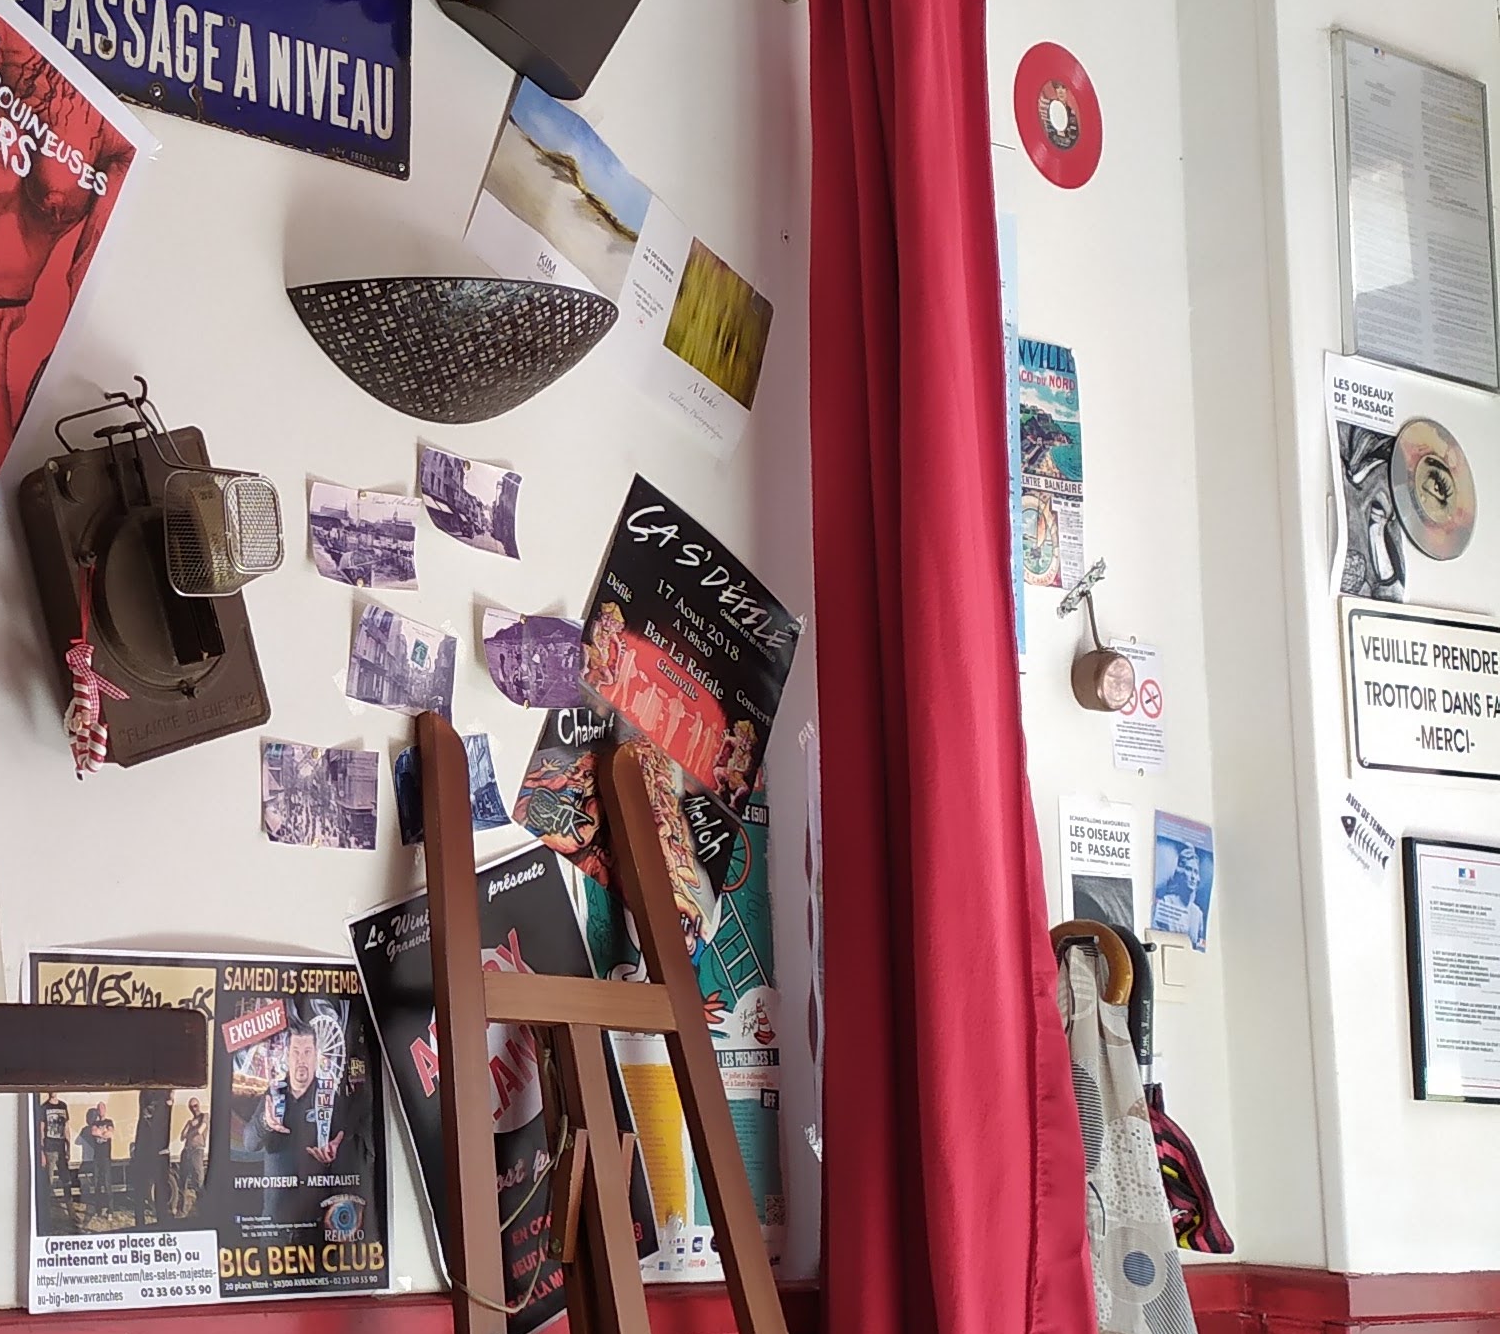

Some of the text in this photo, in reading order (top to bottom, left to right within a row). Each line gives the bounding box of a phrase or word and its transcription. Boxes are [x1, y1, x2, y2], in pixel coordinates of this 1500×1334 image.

[234, 23, 257, 103] A
[269, 33, 395, 142] NIVEAU
[1333, 376, 1394, 403] LES OISEAUX
[1334, 391, 1395, 418] DE PASSAGE
[606, 570, 633, 604] Défilé
[655, 577, 676, 600] 17
[707, 623, 741, 663] 2018
[681, 625, 714, 658] 18h30
[1360, 634, 1500, 676] VEUILLEZ PRENDRE
[643, 619, 725, 701] Bar La Rafale
[655, 656, 700, 701] Granville
[1364, 680, 1482, 717] TROTTOIR DANS
[557, 707, 607, 749] Chabert
[1415, 727, 1476, 755] -MERCI-
[1069, 824, 1131, 844] LES OISEAUX
[1070, 840, 1131, 860] DE PASSAGE
[487, 861, 546, 902] présente
[364, 923, 386, 950] Le
[223, 966, 298, 995] SAMEDI 15
[228, 1007, 283, 1045] EXCLUSIF
[234, 1174, 361, 1189] HYPNOTISEUR MENTALISTE
[36, 1248, 200, 1268] maintenant au Big Ben) ou
[45, 1233, 177, 1254] (prenez vos places dès
[219, 1242, 385, 1278] BIG BEN CLUB
[36, 1289, 124, 1307] au-big-ben-avranches
[141, 1287, 154, 1298] 02
[156, 1286, 168, 1297] 33
[170, 1285, 183, 1296] 60
[199, 1284, 212, 1295] 90
